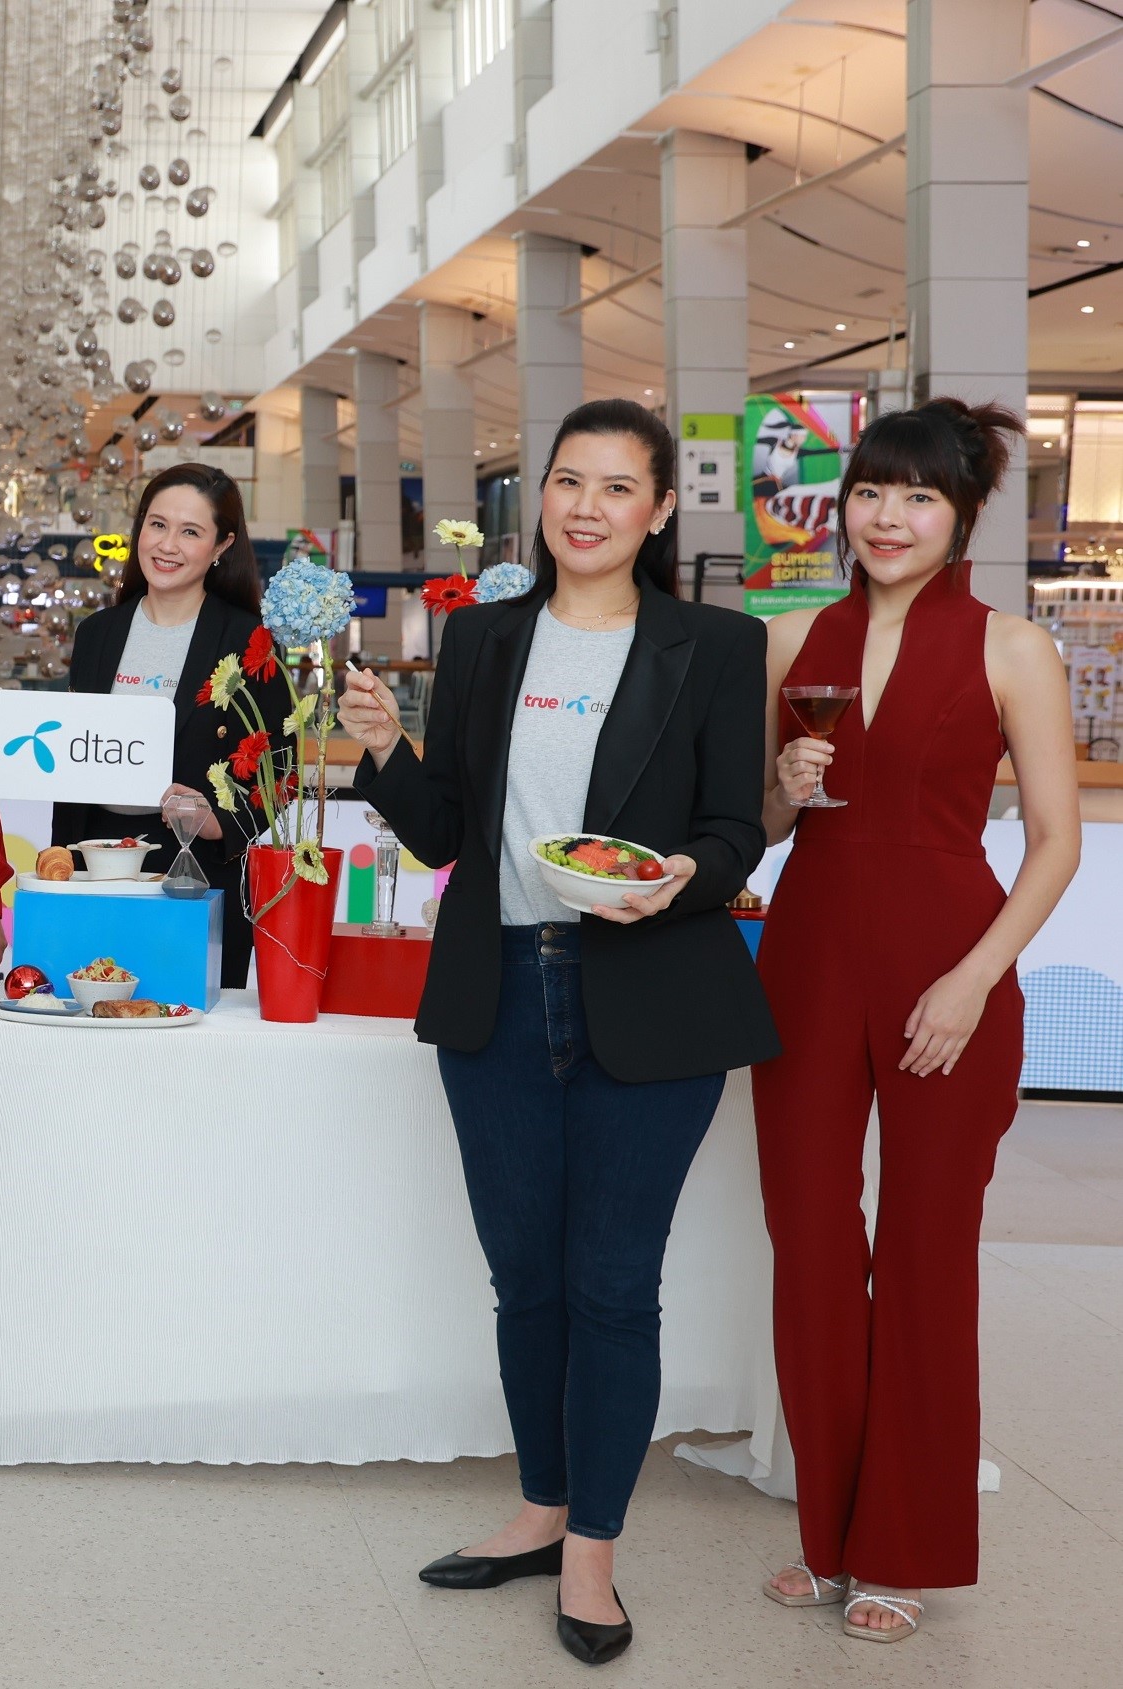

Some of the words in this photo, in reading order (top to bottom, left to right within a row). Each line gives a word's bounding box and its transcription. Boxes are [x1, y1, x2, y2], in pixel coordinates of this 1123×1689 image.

[686, 422, 697, 436] 3
[771, 552, 833, 567] SUMMER
[771, 566, 833, 581] EDITION
[116, 673, 141, 685] true
[162, 678, 178, 688] dta
[524, 694, 559, 709] true
[590, 701, 612, 714] dta
[69, 729, 145, 766] dtac
